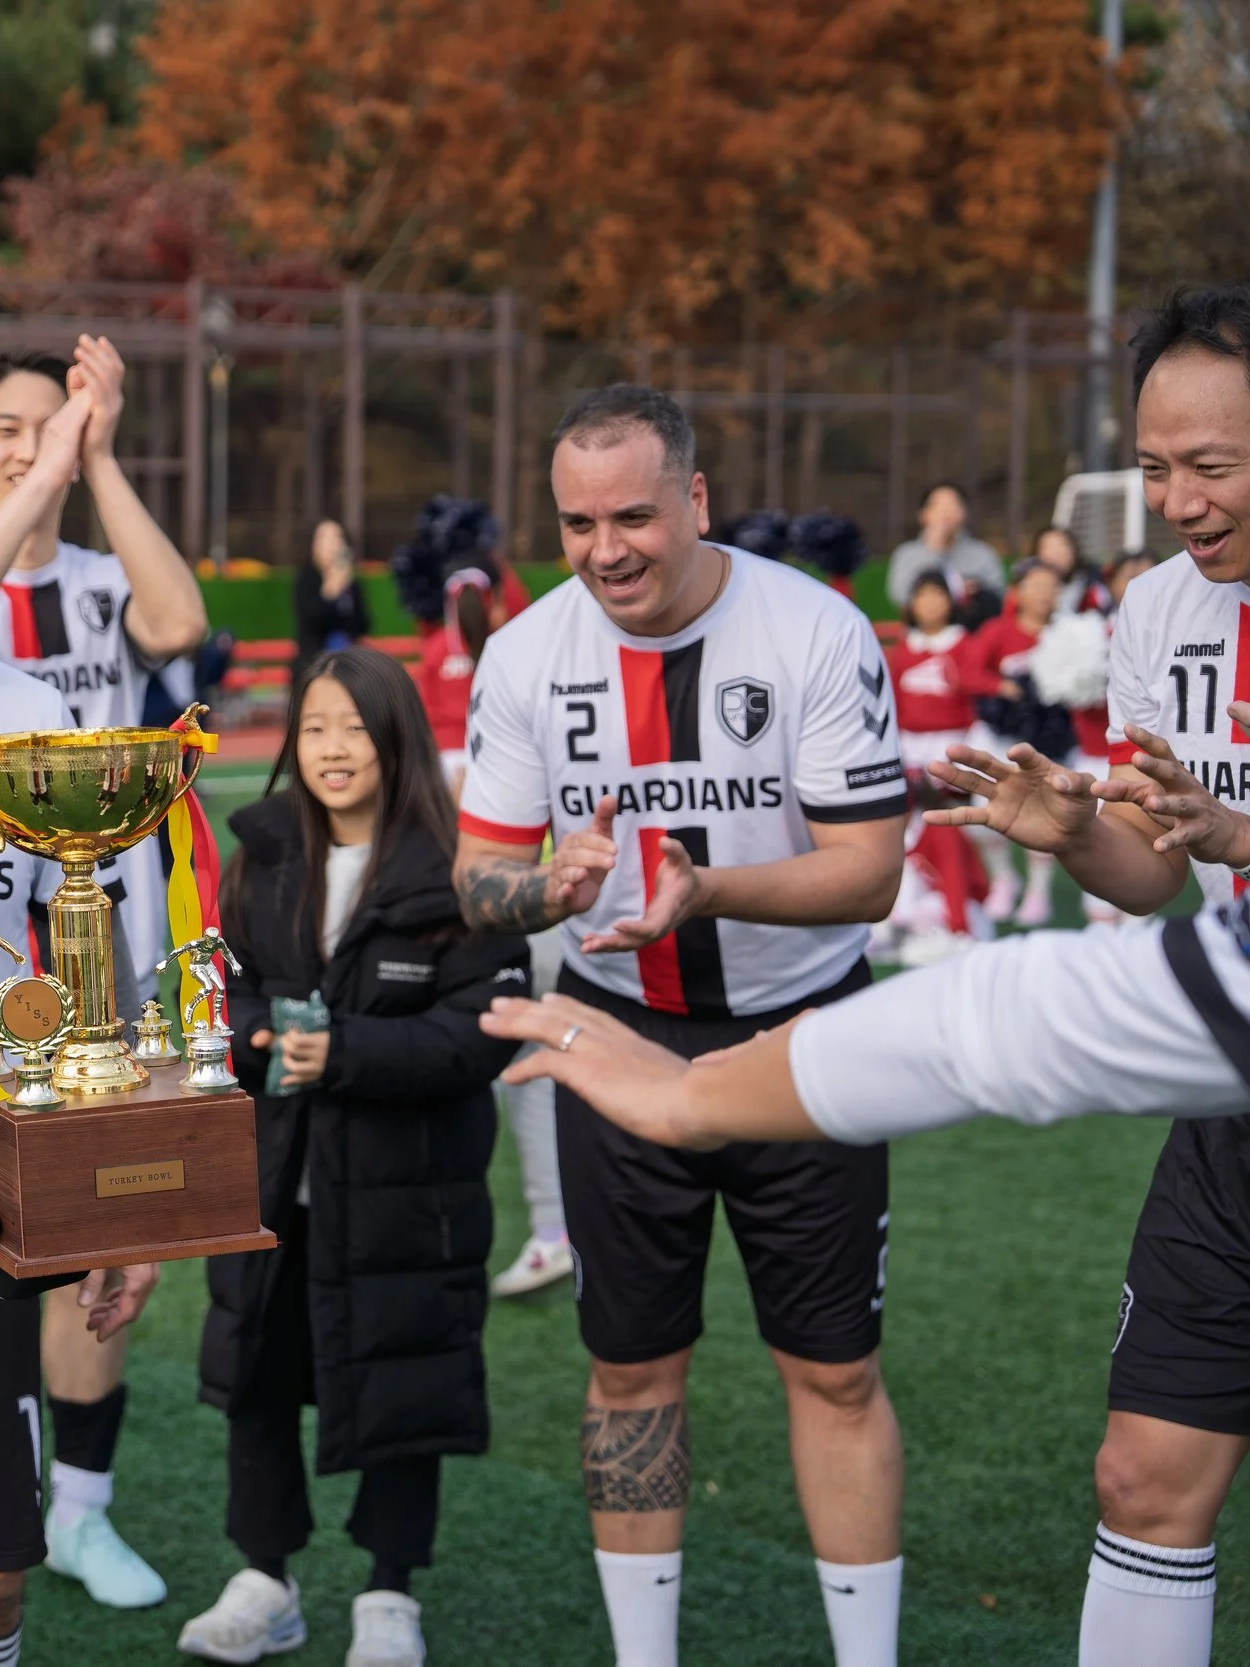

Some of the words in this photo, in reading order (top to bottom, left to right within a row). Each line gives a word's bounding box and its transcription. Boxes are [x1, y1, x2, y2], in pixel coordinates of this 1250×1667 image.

[1174, 638, 1225, 656] ummel
[1168, 664, 1218, 733] 11
[565, 701, 599, 761] 2
[109, 1174, 144, 1185] TURKEY
[148, 1172, 172, 1182] BOWL
